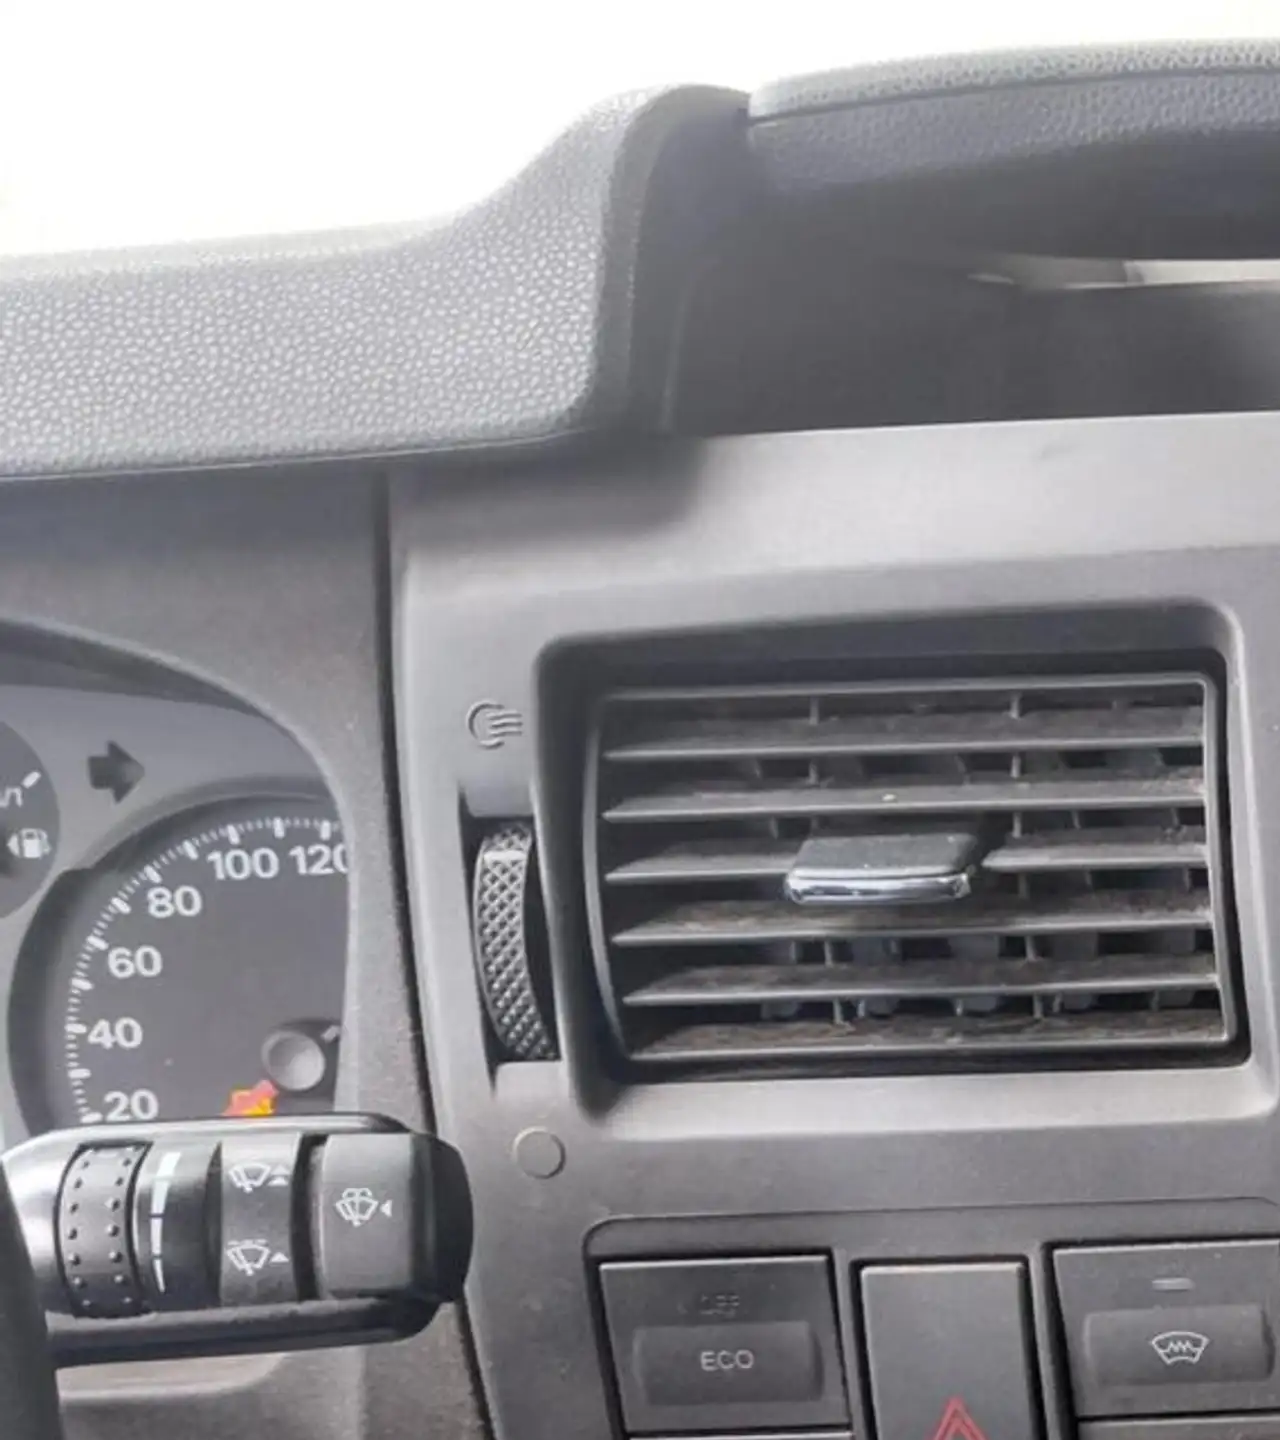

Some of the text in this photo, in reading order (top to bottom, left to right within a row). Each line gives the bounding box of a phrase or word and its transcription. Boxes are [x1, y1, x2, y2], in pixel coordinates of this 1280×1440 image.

[207, 847, 278, 880] 100
[147, 886, 202, 918] 80
[108, 947, 162, 978] 60
[88, 1018, 143, 1048] 40
[103, 1091, 158, 1122] 20
[700, 1349, 755, 1372] ECO
